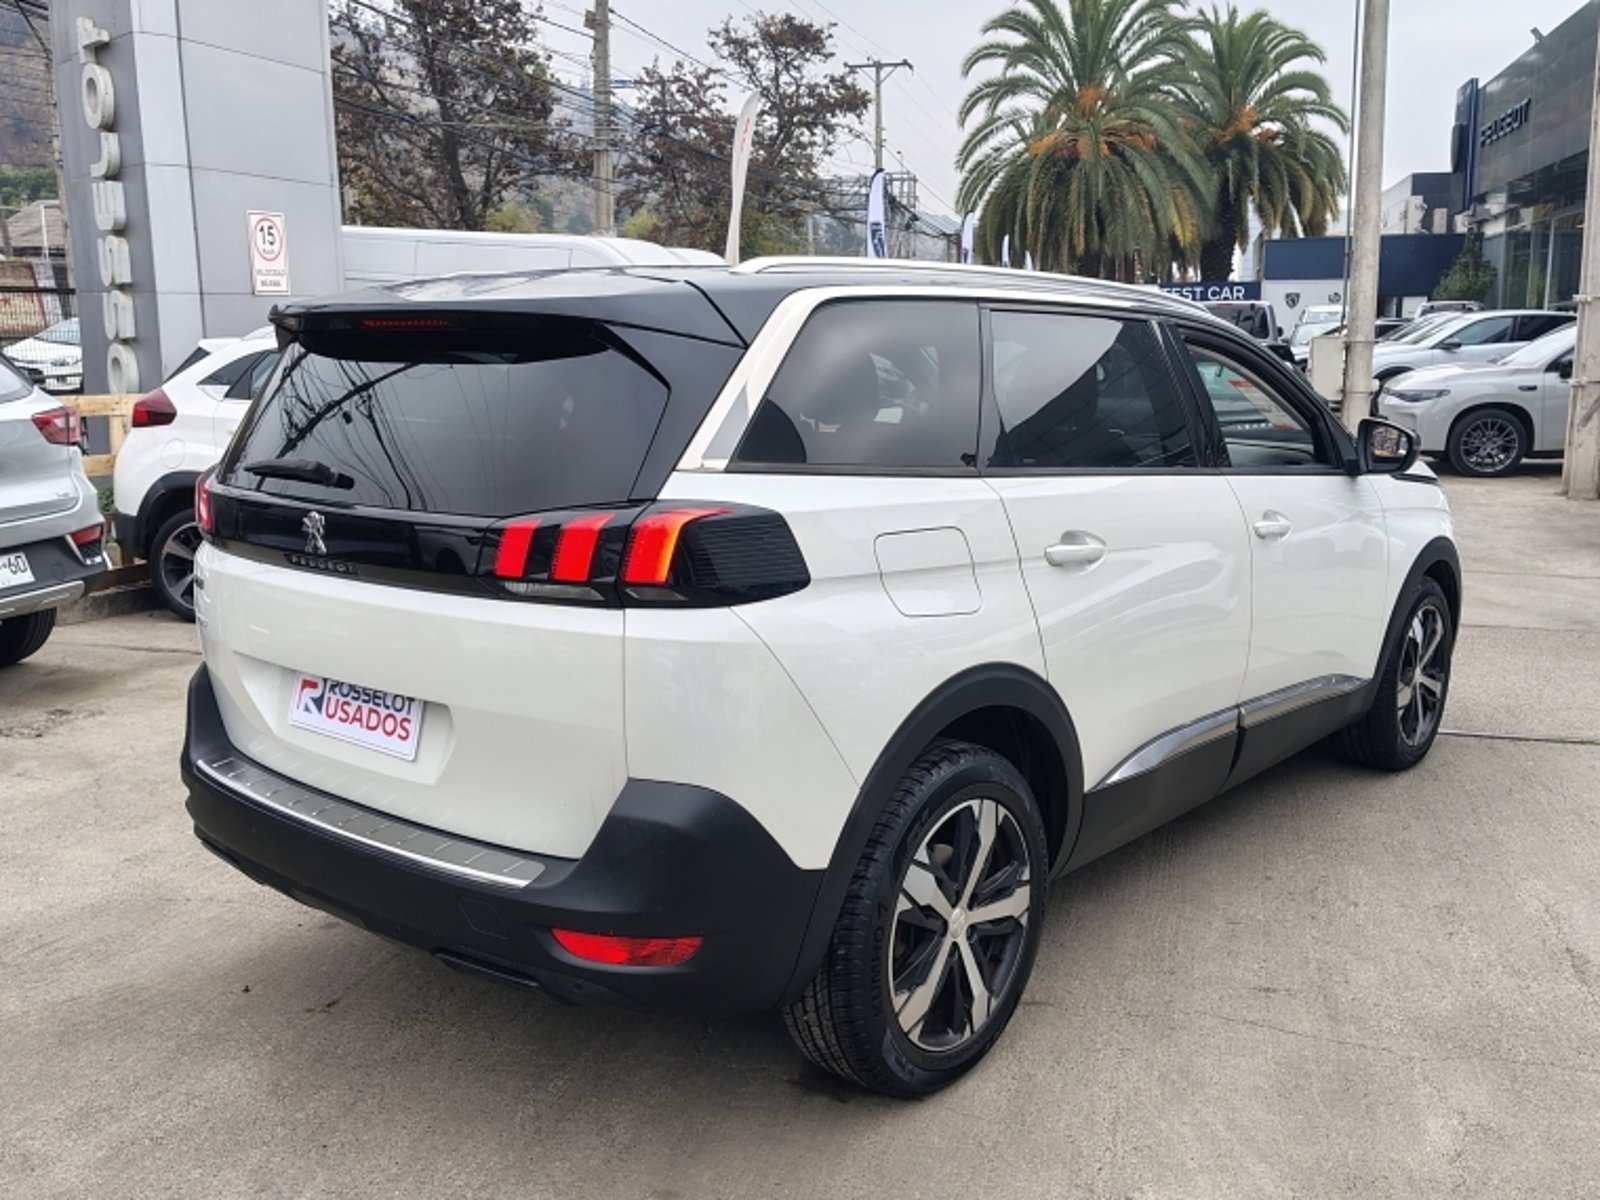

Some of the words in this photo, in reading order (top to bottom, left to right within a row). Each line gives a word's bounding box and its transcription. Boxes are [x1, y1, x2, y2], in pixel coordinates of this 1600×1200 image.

[75, 16, 140, 395] OSSELOT
[259, 225, 276, 246] 15
[1207, 285, 1245, 300] CAR
[328, 679, 416, 715] ROSSELOT
[325, 697, 412, 742] USADOS
